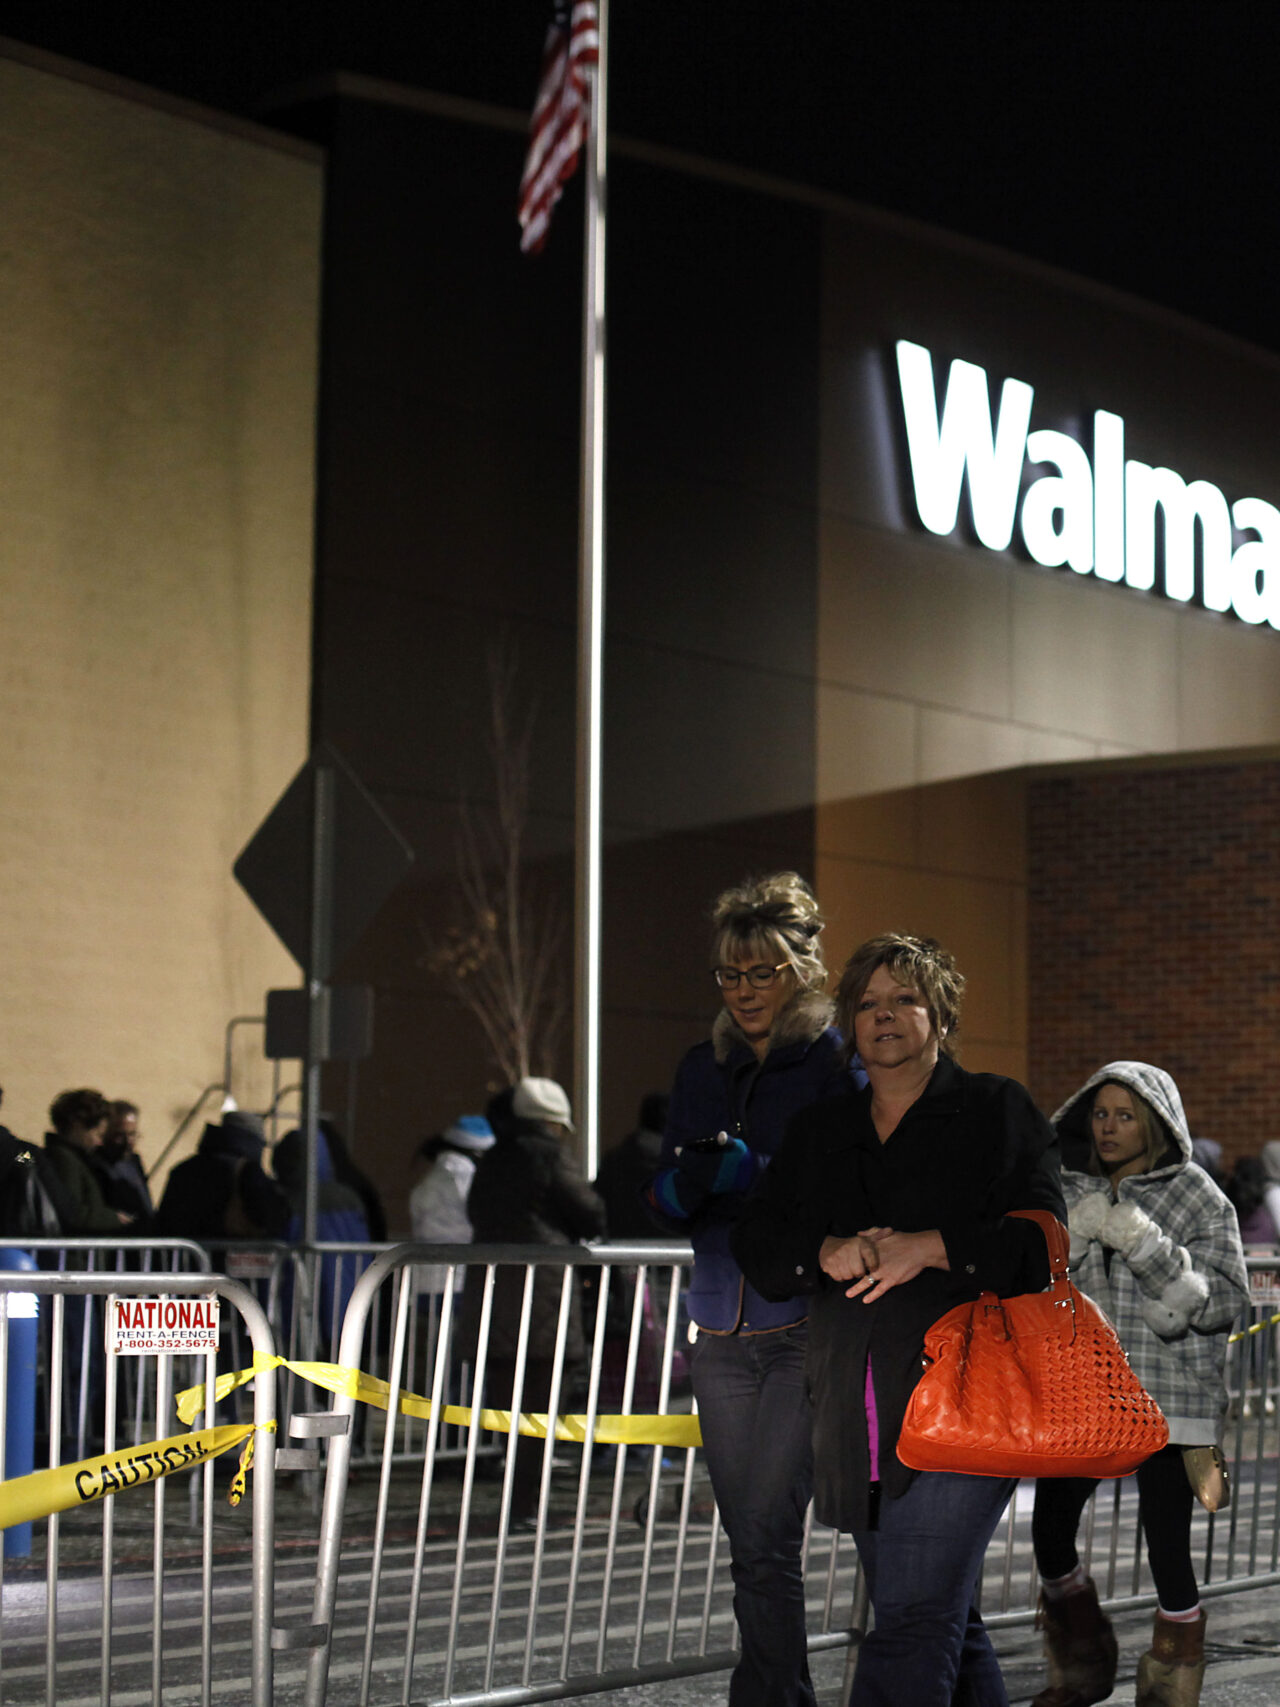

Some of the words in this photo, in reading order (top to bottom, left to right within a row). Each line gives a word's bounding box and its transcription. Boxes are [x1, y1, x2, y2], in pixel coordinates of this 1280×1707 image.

[118, 1302, 216, 1329] NATIONAL
[117, 1330, 216, 1339] RENT-A-FENCE
[117, 1339, 216, 1348] 1-800-352-5675
[75, 1441, 208, 1501] CAUTION
